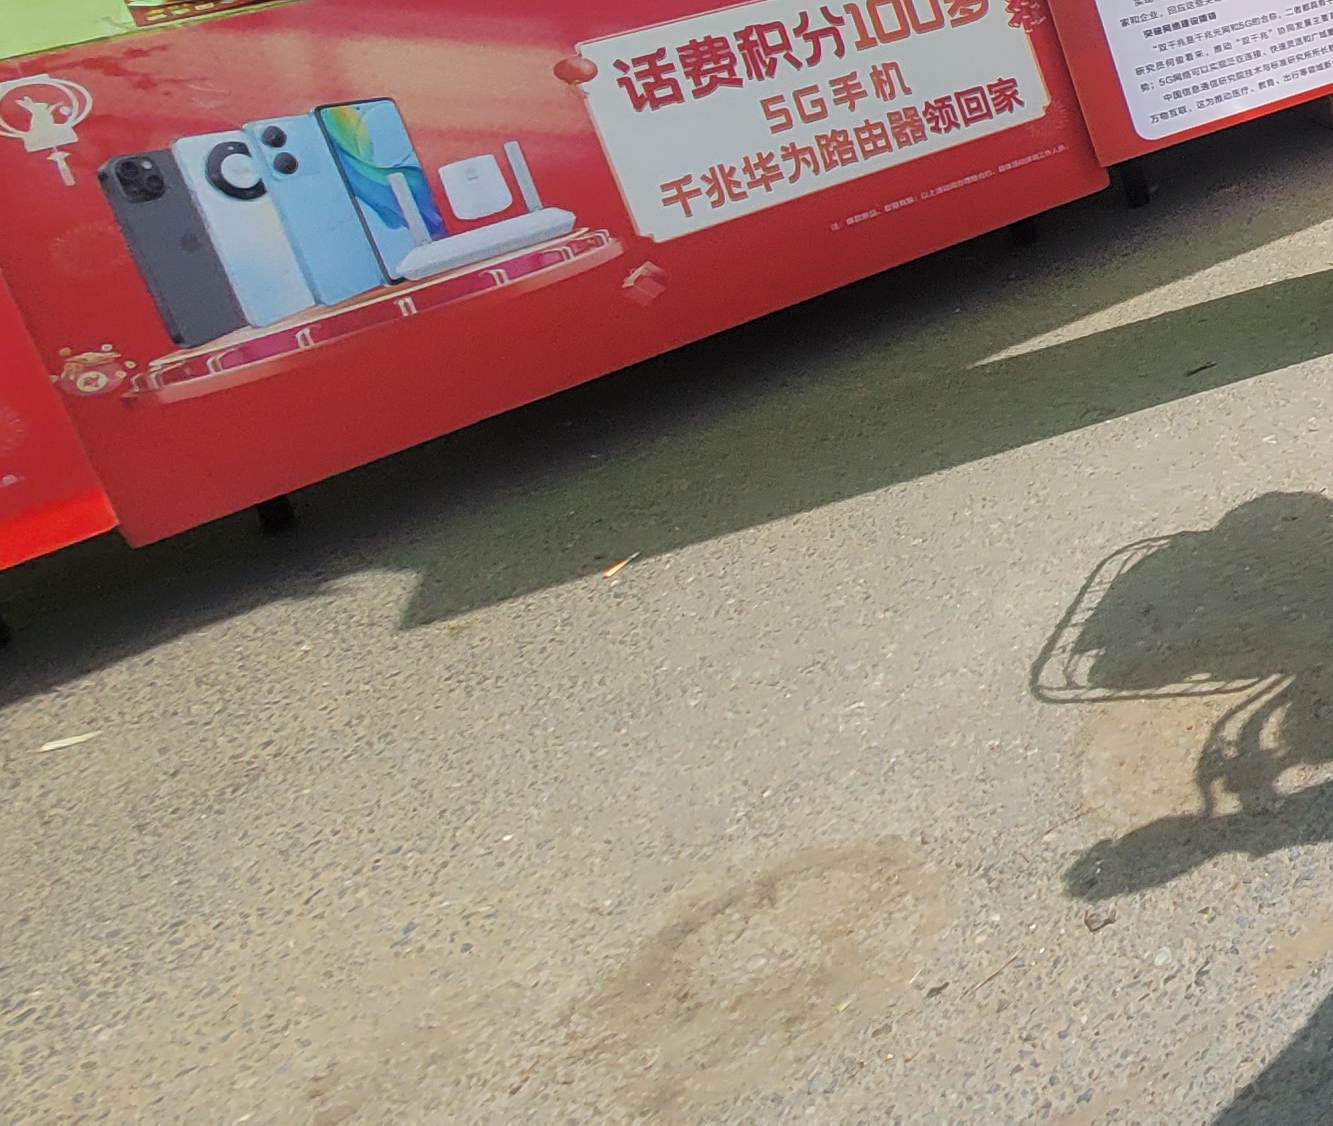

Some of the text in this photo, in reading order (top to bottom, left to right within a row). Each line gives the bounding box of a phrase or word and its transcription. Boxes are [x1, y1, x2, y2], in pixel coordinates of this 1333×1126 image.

[660, 76, 1026, 219] 千兆华为路由器领回家
[760, 60, 914, 134] 5G手机
